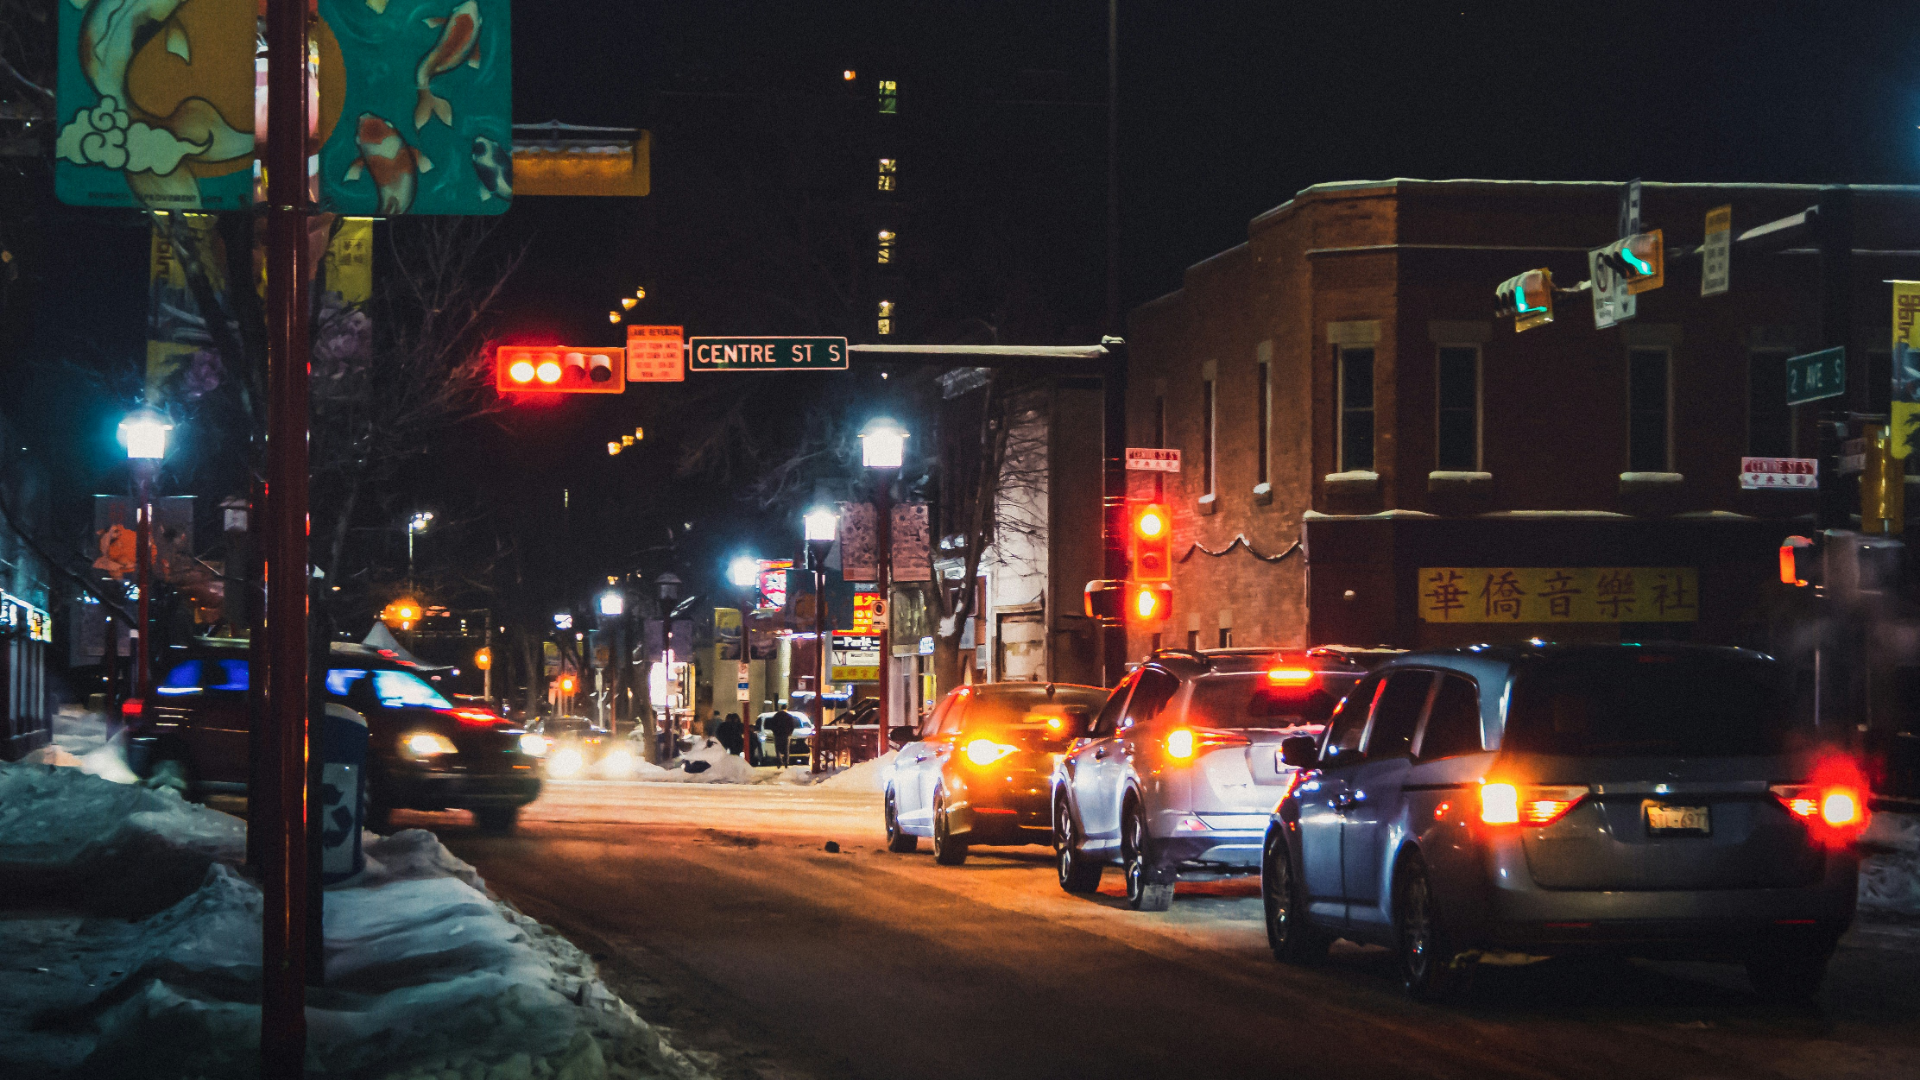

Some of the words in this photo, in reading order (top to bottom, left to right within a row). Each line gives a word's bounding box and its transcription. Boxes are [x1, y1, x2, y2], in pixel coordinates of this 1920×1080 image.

[697, 344, 776, 363] CENTRE
[792, 344, 814, 362] ST
[829, 344, 841, 362] S
[1790, 368, 1798, 394] 2
[1805, 362, 1823, 389] AVE
[1834, 358, 1842, 384] S
[1425, 570, 1697, 620] 華僑音樂社
